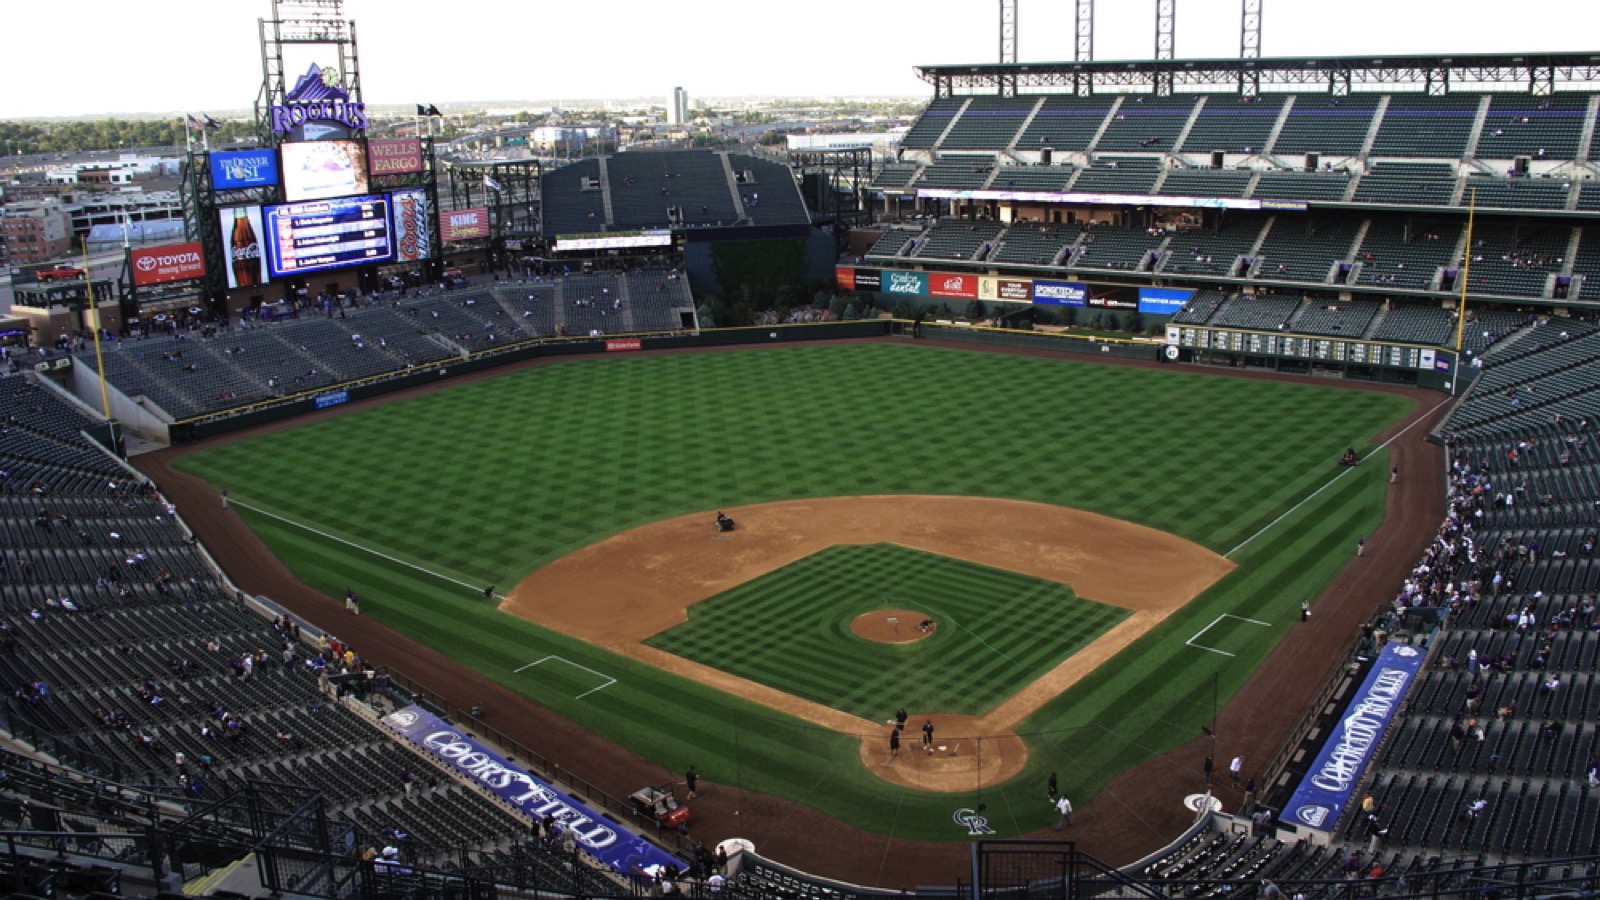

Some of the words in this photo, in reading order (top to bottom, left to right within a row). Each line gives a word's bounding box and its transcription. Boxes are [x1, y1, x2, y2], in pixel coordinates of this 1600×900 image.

[269, 103, 368, 133] ROCKIES
[371, 142, 417, 157] WELLS
[233, 156, 269, 168] DENVER
[374, 157, 418, 171] FARGO
[226, 166, 259, 181] POST
[450, 212, 478, 227] KING
[400, 198, 417, 259] Coors
[156, 252, 200, 266] TOYOTA
[158, 266, 180, 275] moving
[180, 262, 201, 272] forward
[889, 281, 921, 294] dental
[1311, 714, 1382, 793] COLORADO
[1353, 666, 1410, 720] ROCKIES
[423, 730, 519, 790] COORS
[510, 781, 618, 849] FIELD
